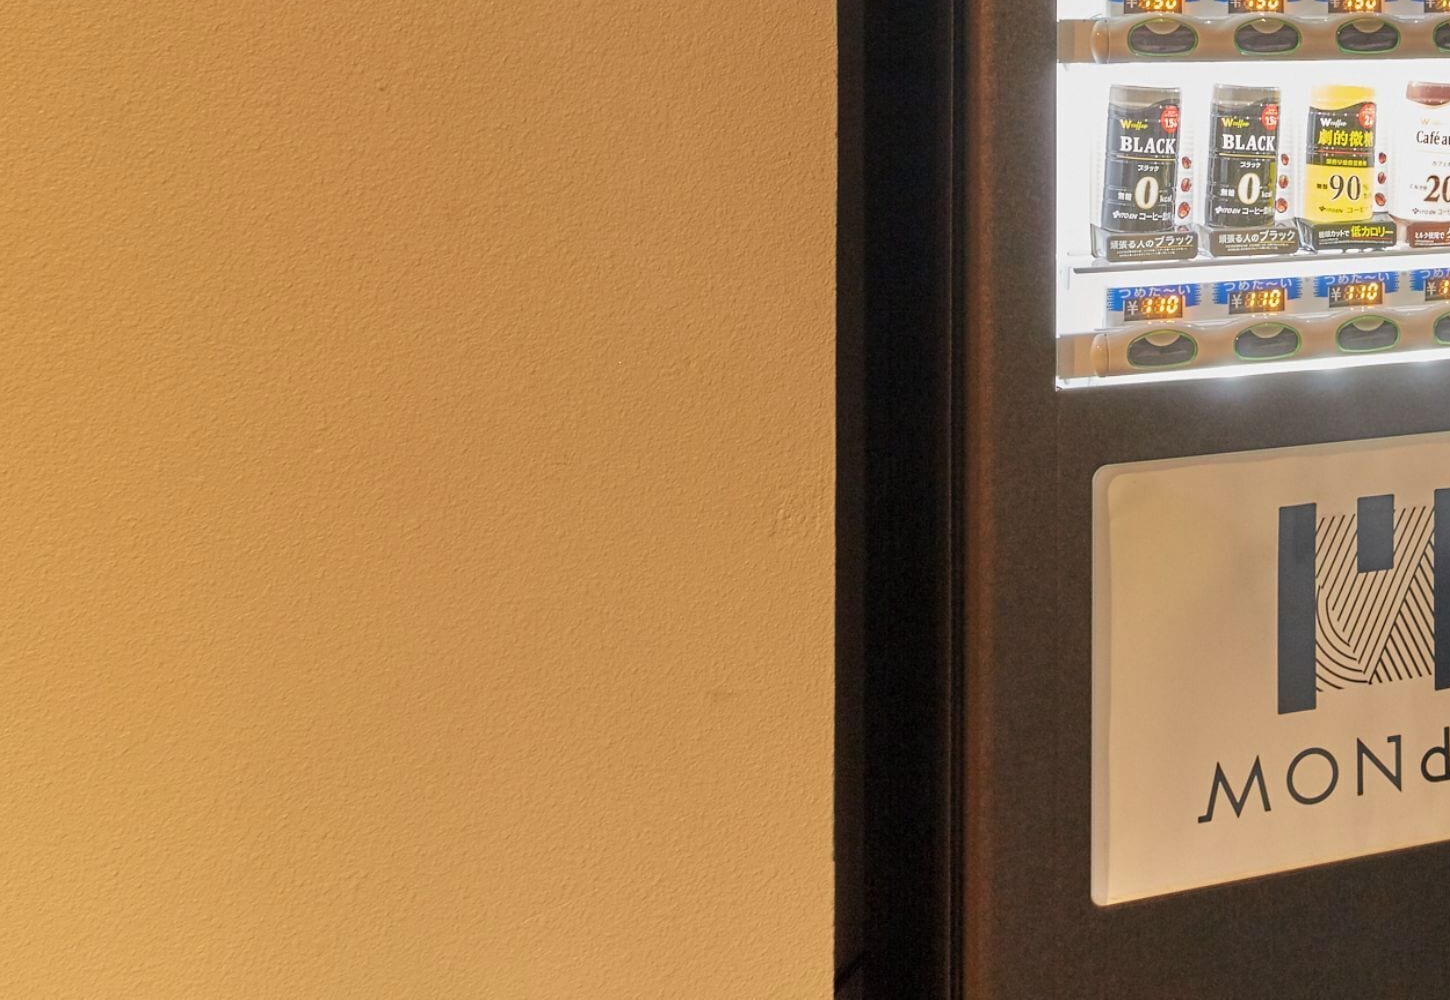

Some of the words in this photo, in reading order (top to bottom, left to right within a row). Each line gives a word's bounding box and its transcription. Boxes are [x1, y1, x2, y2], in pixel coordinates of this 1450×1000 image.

[1120, 135, 1176, 154] BLACK
[1222, 133, 1276, 151] BLACK
[1416, 131, 1440, 145] Café
[1137, 164, 1159, 172] ブラック
[1239, 161, 1262, 169] ブラック
[1135, 176, 1159, 209] 0
[1237, 172, 1261, 205] 0
[1329, 174, 1361, 201] 90
[1351, 225, 1394, 238] 低カロリー
